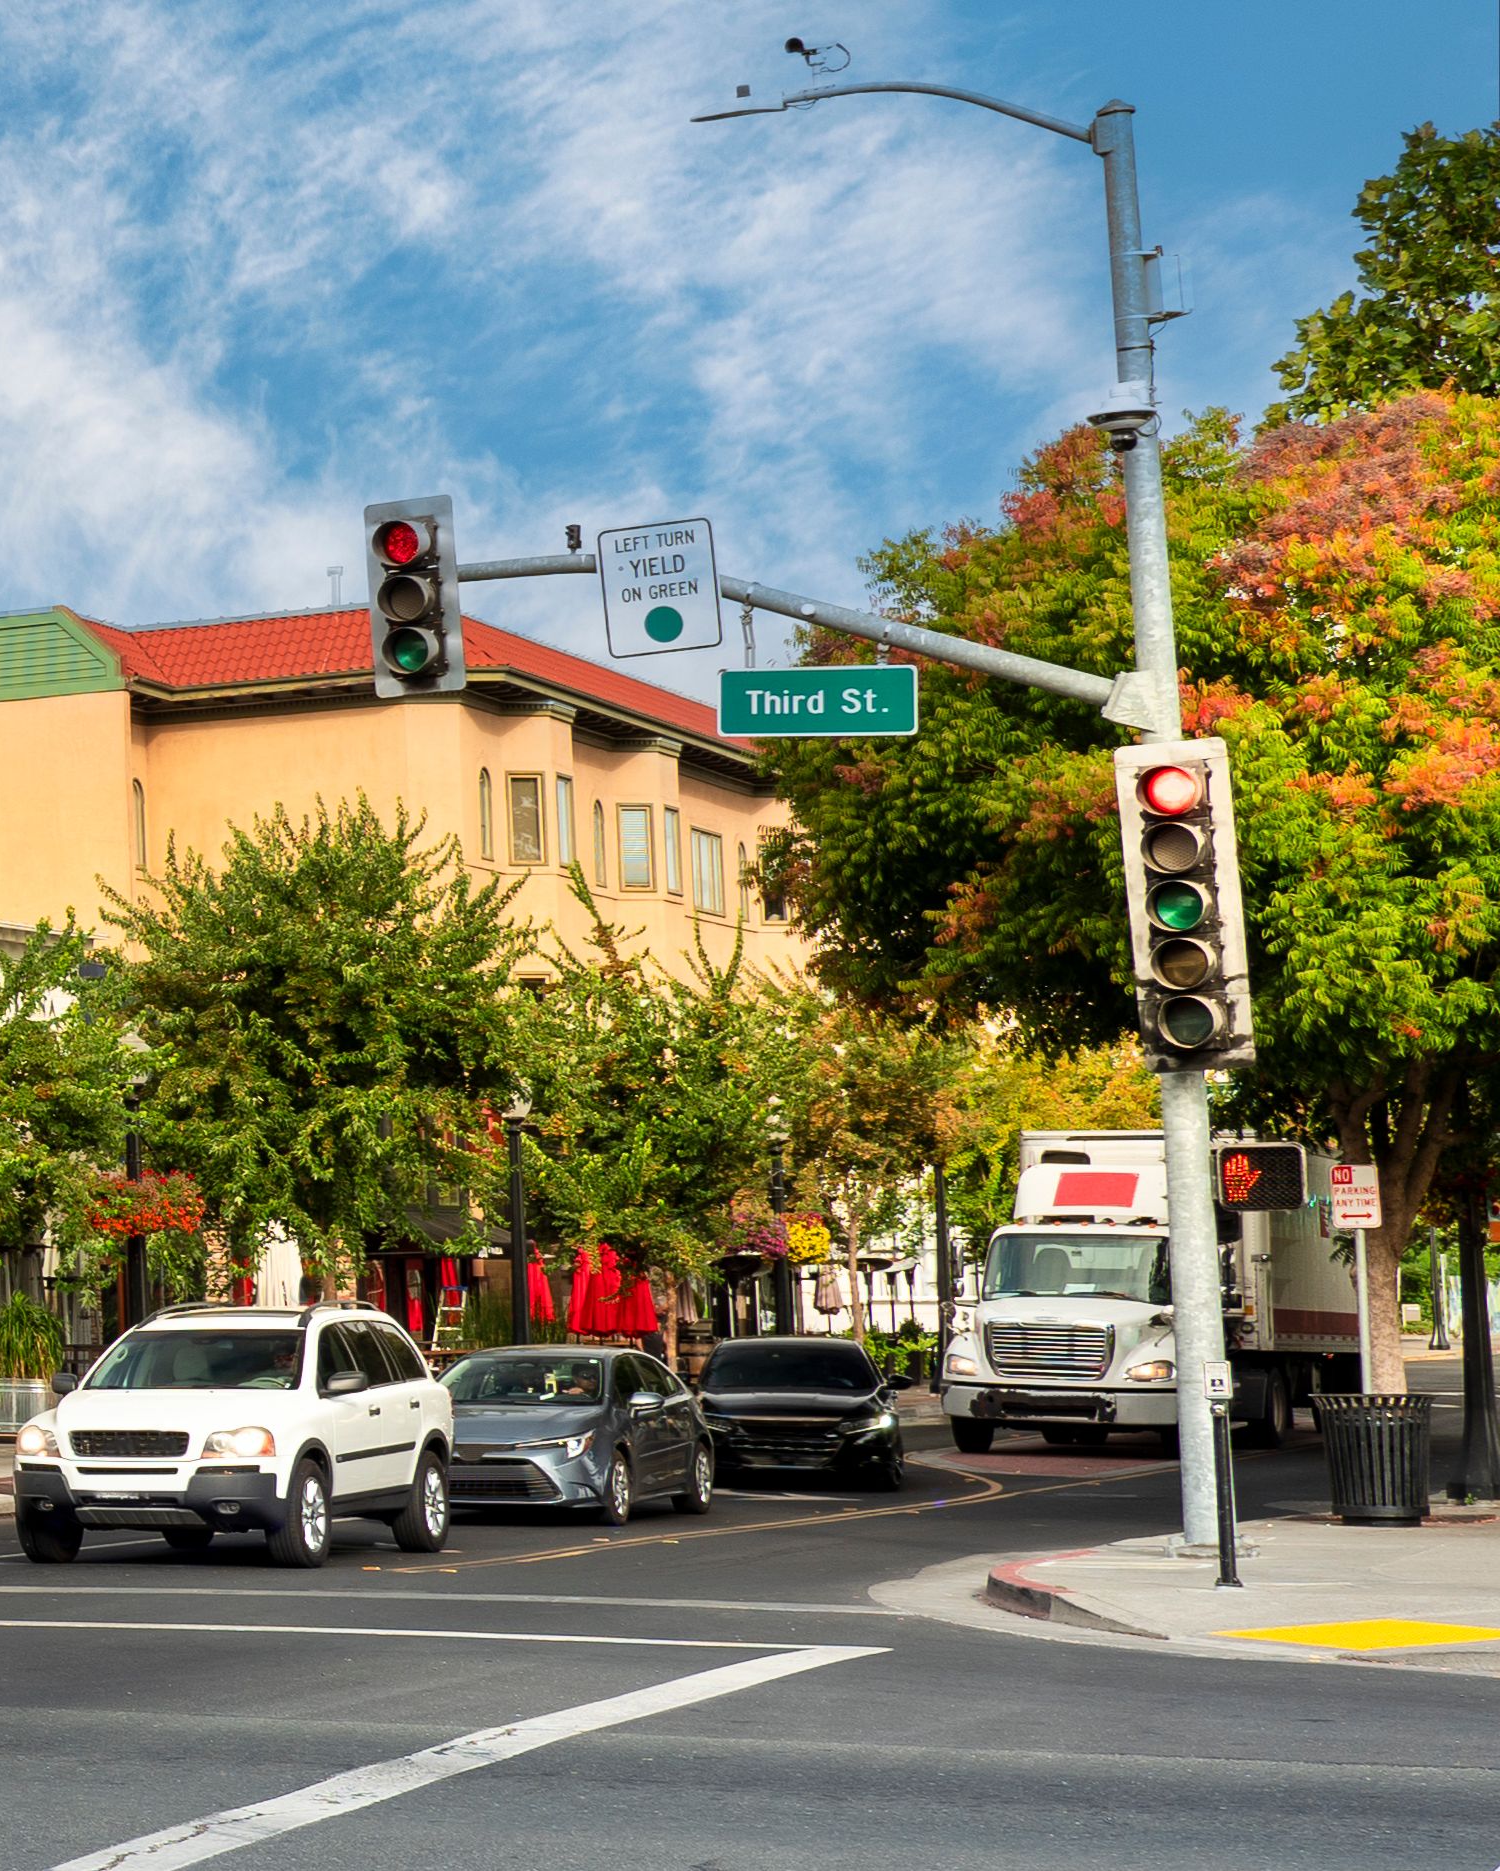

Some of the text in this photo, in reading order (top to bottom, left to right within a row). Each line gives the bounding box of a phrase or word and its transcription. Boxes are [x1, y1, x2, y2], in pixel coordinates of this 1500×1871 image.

[614, 529, 695, 554] LEFT TURN
[629, 554, 686, 579] YIELD
[622, 578, 699, 603] ON GREEN
[745, 688, 890, 715] Third St.
[1334, 1169, 1350, 1183] NO
[1334, 1186, 1376, 1195] PARKING
